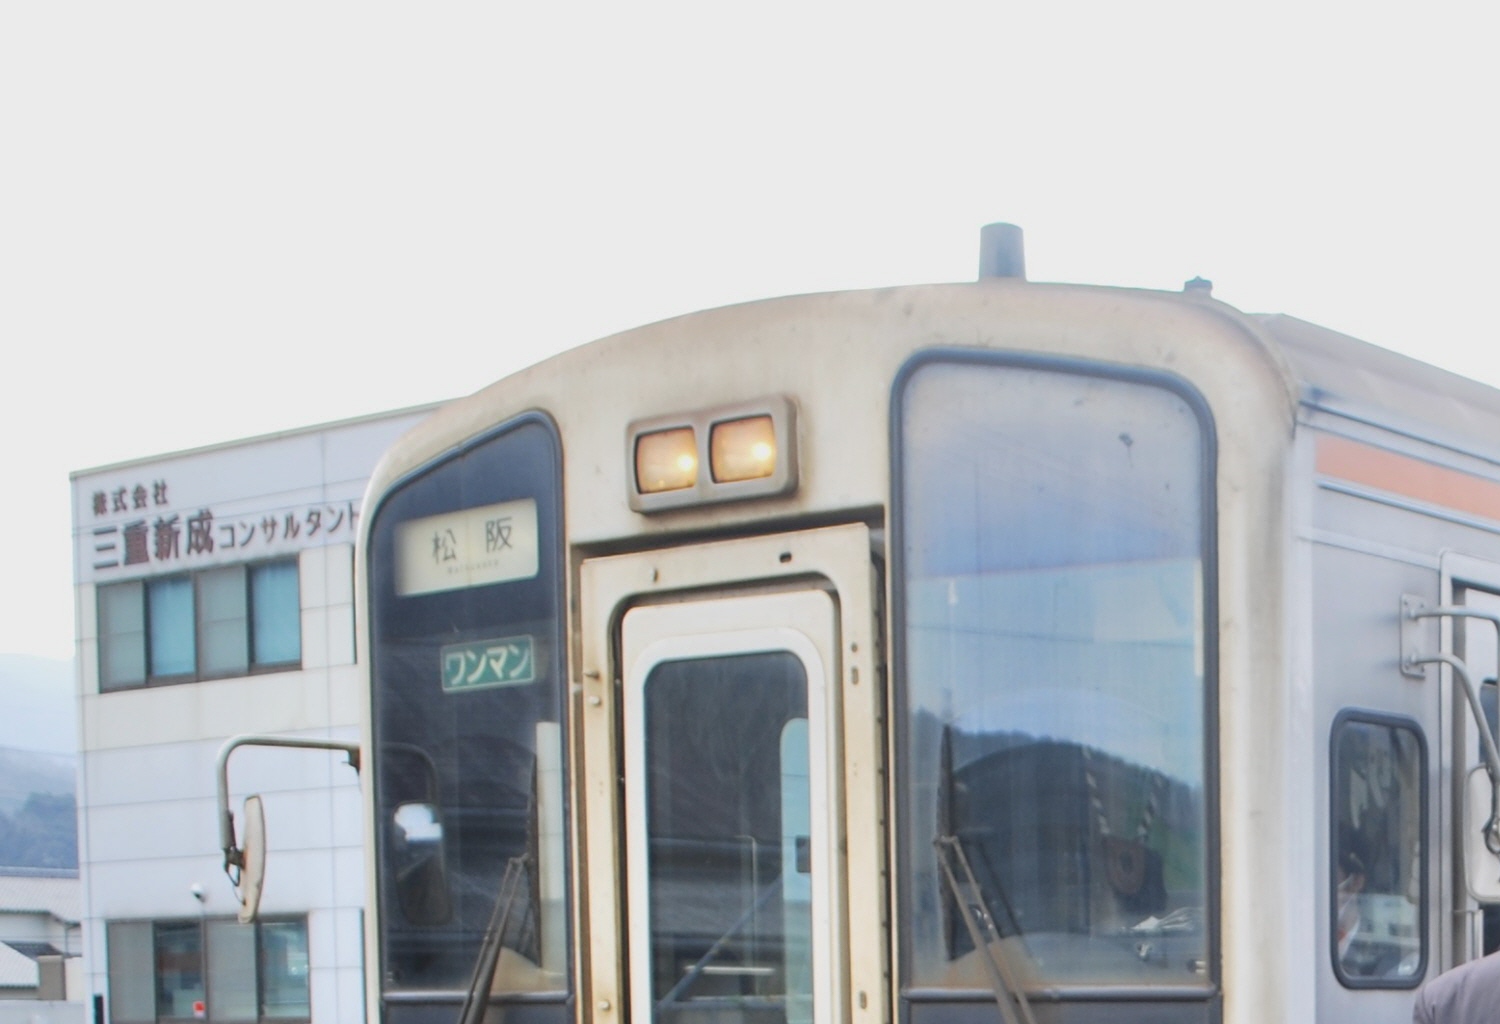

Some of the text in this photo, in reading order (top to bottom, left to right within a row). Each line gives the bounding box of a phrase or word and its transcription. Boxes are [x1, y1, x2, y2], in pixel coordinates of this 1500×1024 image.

[93, 479, 168, 516] 株式会社
[432, 516, 513, 565] 松阪
[445, 643, 531, 685] ワンマン
